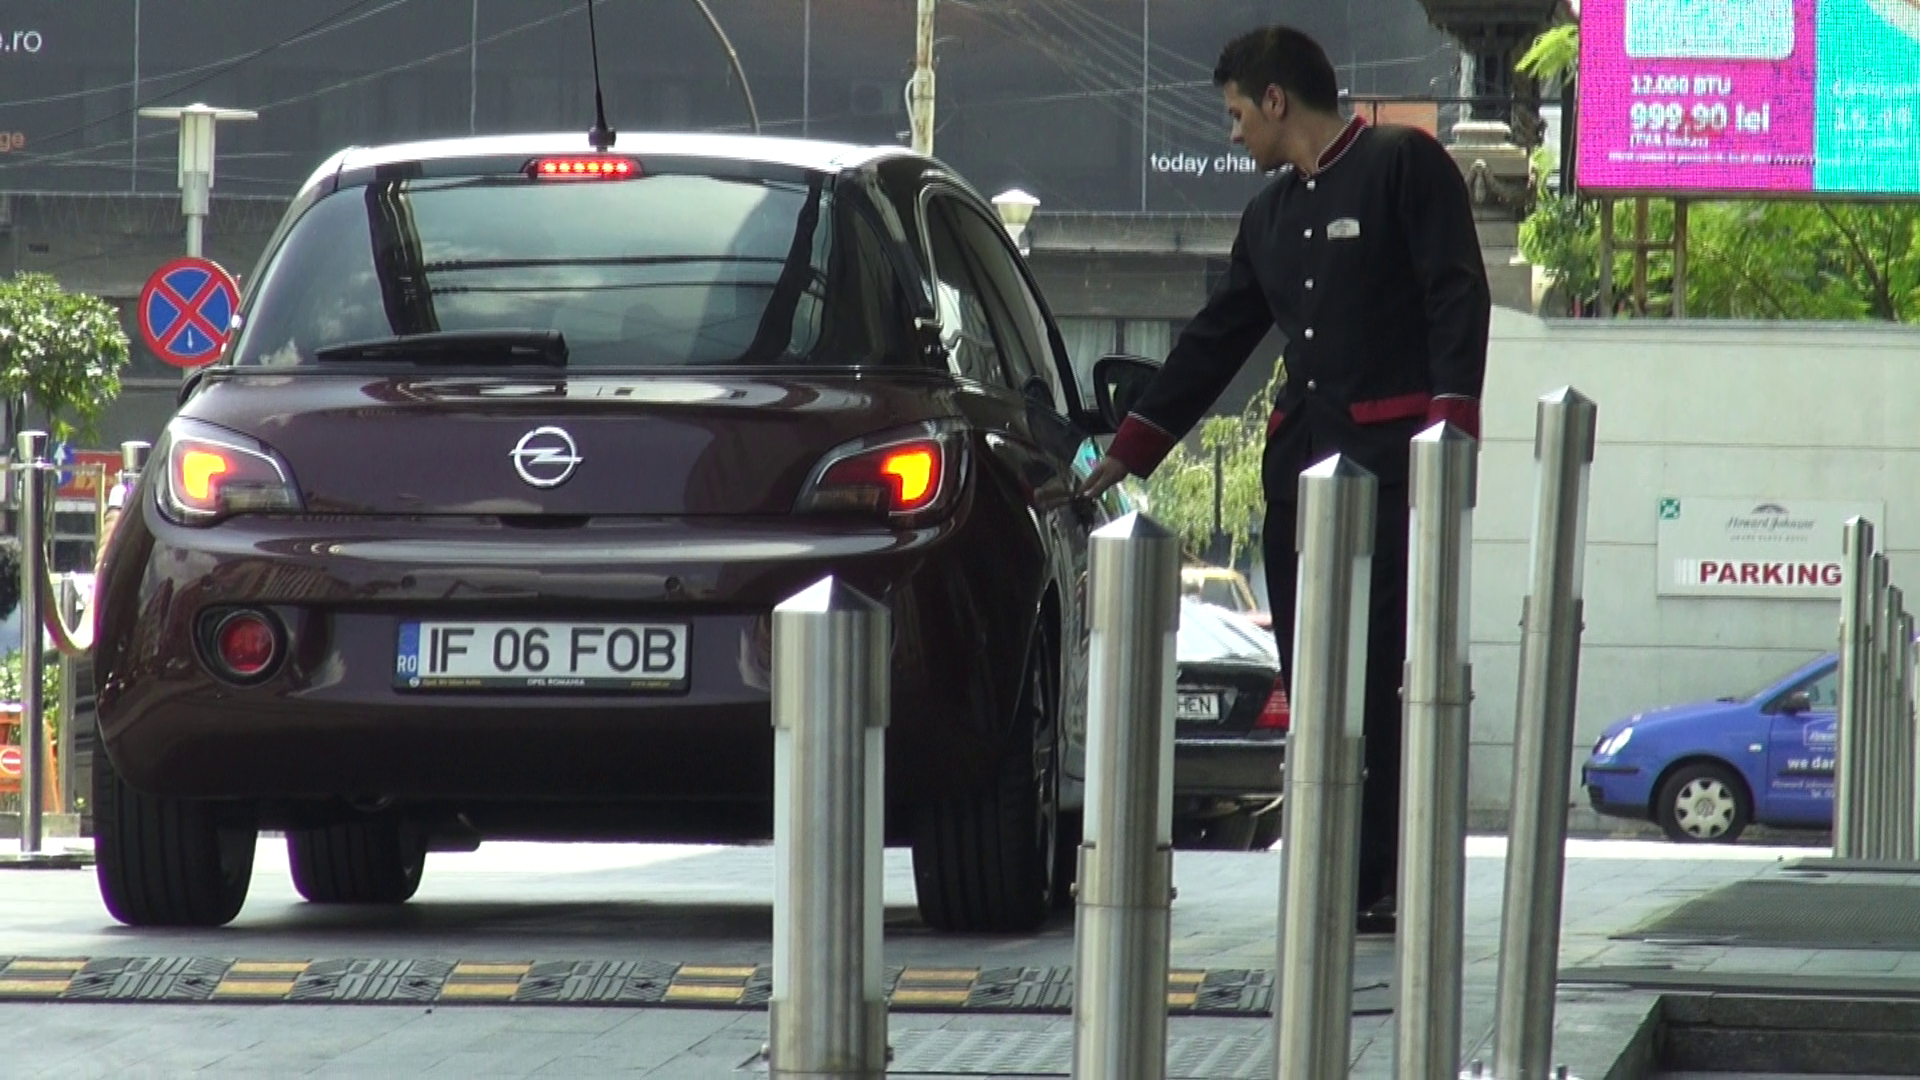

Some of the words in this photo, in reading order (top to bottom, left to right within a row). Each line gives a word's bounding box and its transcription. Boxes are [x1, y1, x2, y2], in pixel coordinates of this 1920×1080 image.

[0, 30, 42, 52] .ro
[1735, 102, 1770, 132] lei
[1150, 153, 1208, 177] today
[1700, 561, 1843, 586] PARKING
[429, 627, 475, 673] IF
[493, 627, 550, 672] 06
[570, 627, 676, 673] FOB
[397, 655, 417, 673] RO
